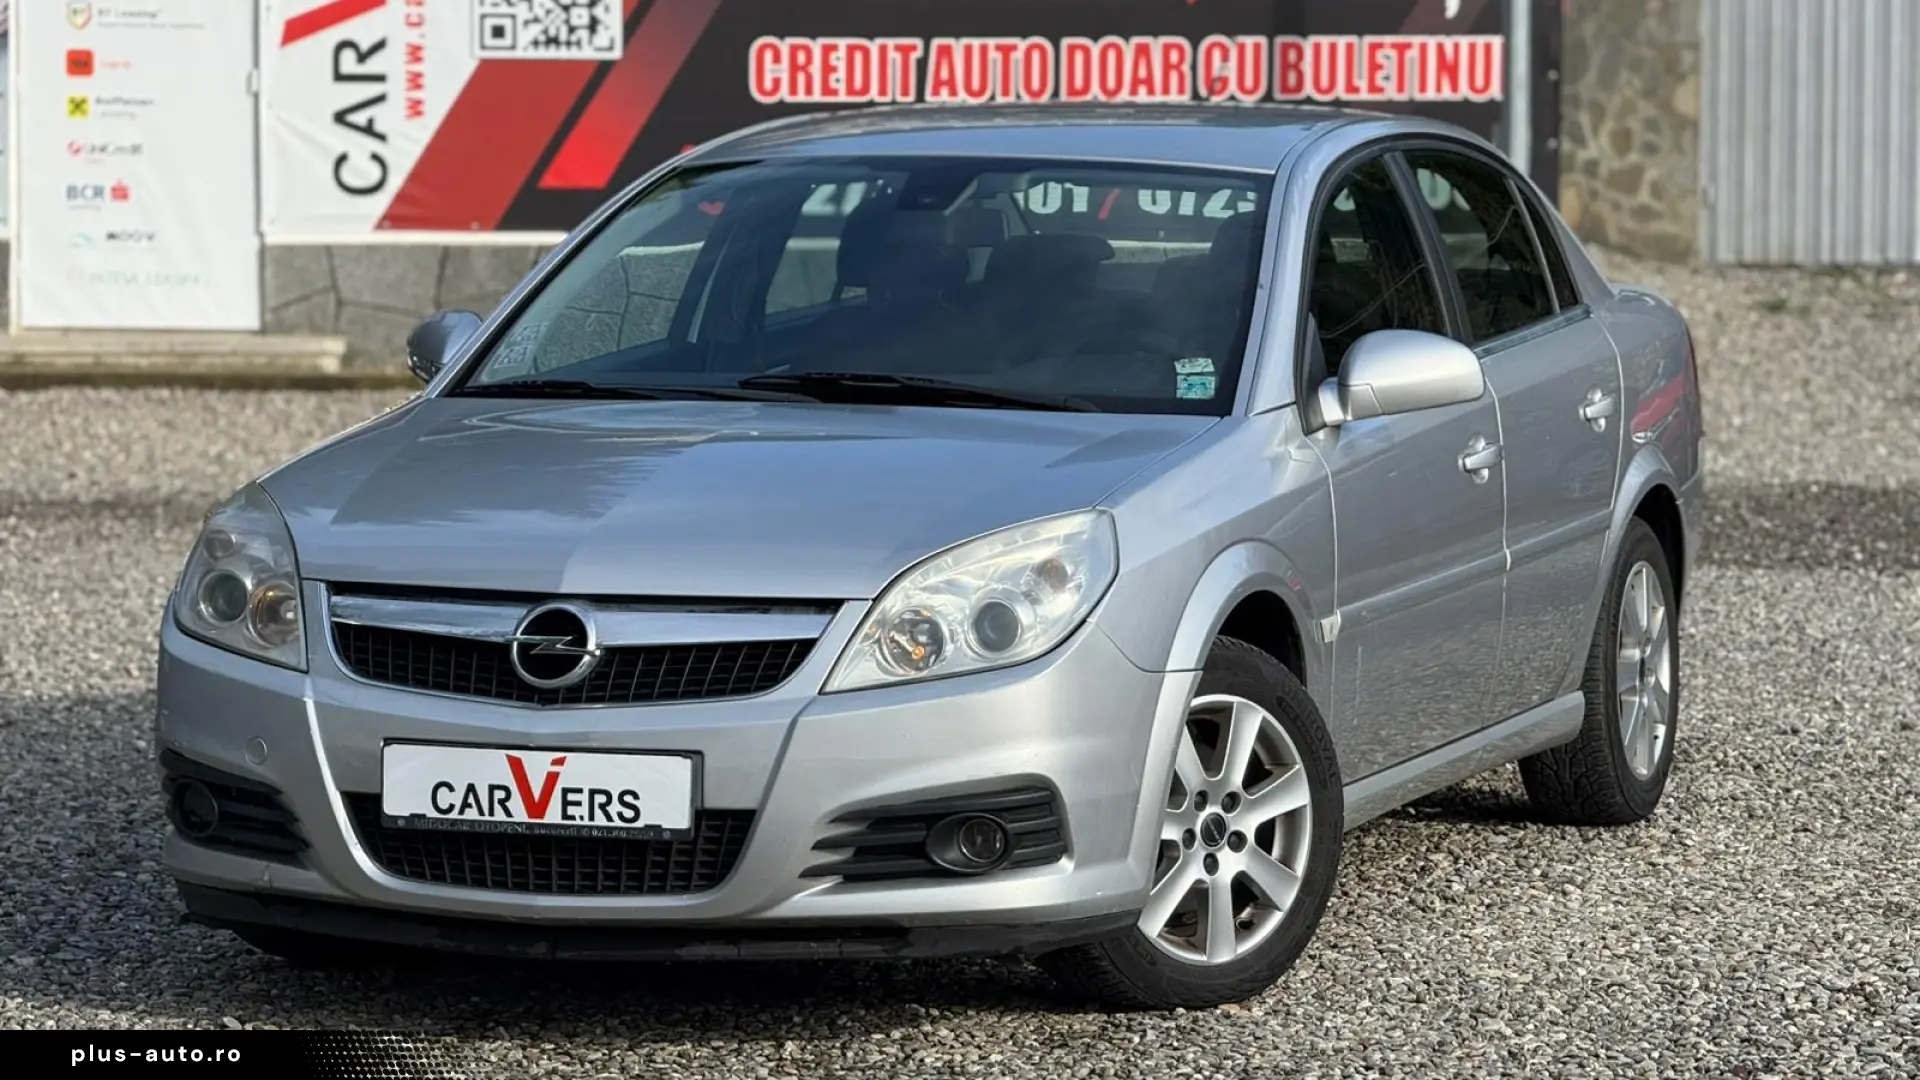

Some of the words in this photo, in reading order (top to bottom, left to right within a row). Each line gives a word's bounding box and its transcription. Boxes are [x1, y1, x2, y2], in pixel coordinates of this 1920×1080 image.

[749, 36, 922, 102] CREDIT
[925, 36, 1055, 102] AUTO
[1059, 36, 1191, 102] DOAR
[1197, 36, 1267, 102] CU
[1272, 35, 1504, 102] BULETINU
[333, 37, 387, 195] CAR
[431, 754, 643, 824] CARVERS
